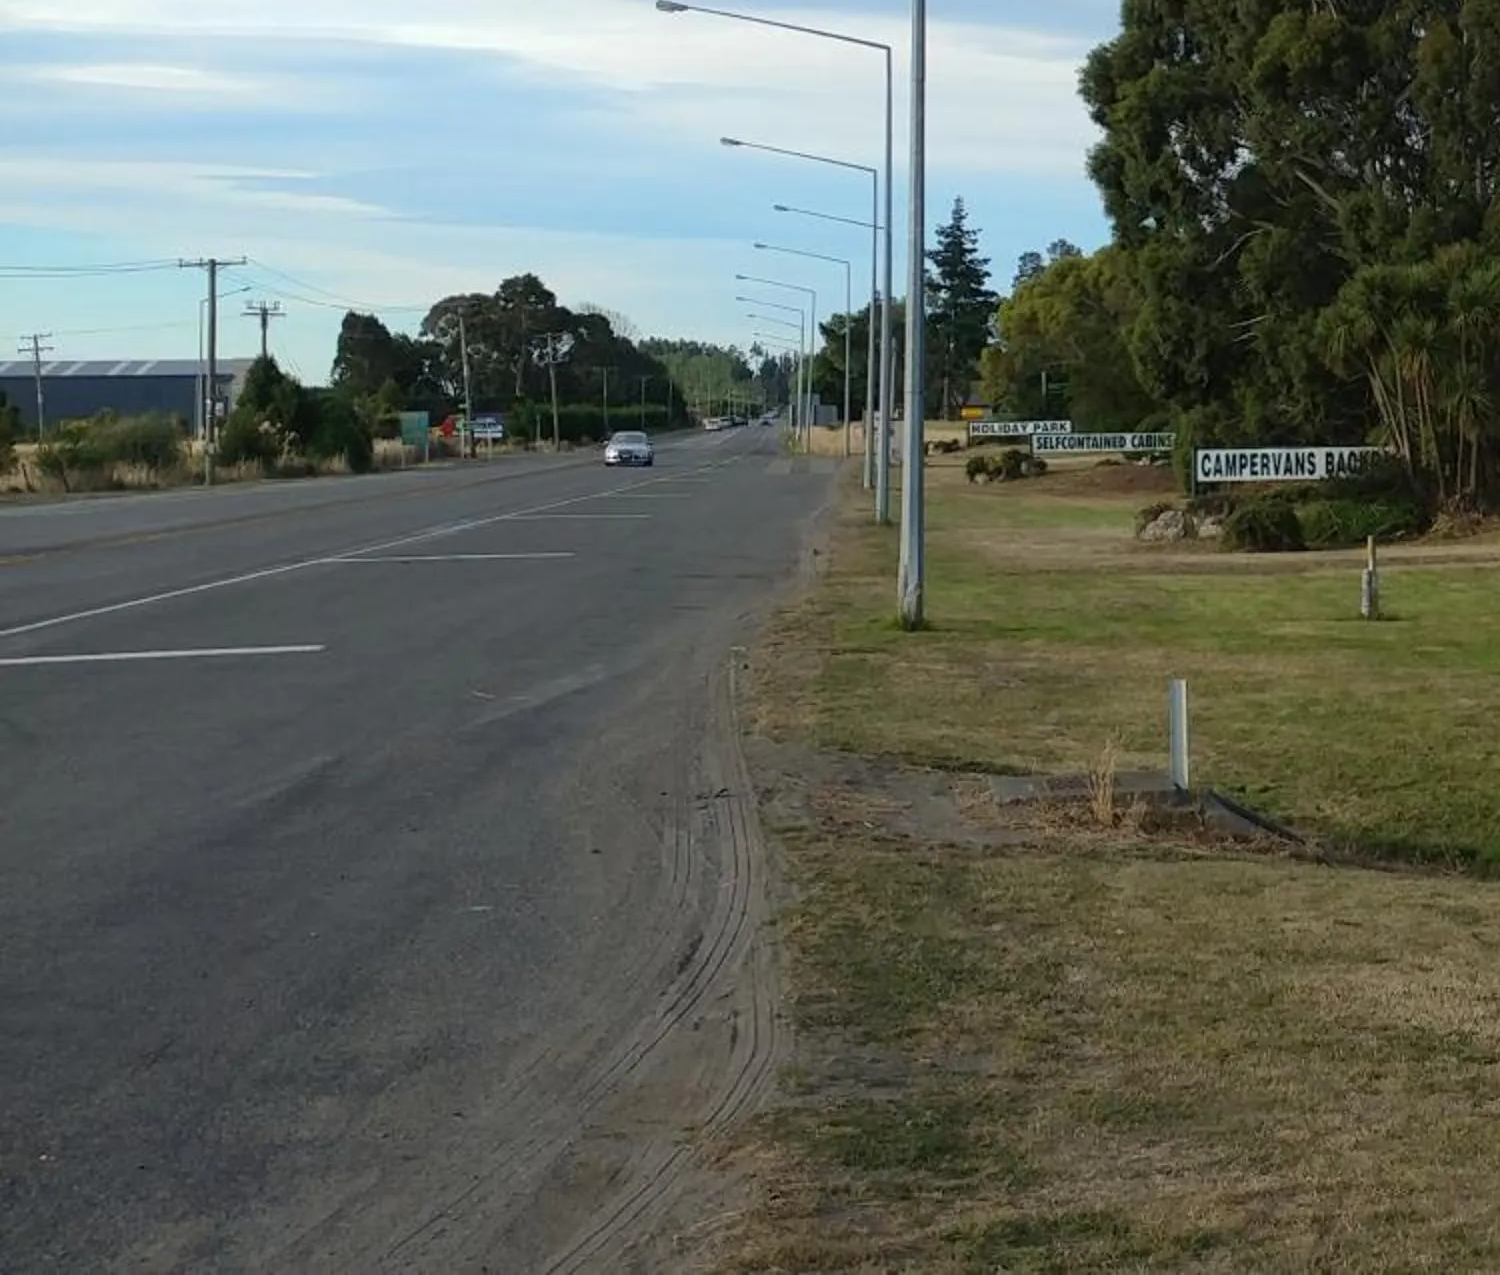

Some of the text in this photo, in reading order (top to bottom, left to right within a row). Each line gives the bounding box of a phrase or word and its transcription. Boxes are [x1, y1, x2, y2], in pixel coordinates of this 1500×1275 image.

[971, 421, 1067, 434] HOLIDAY PARK
[1035, 434, 1174, 450] SELFCONTAINED CABINS
[1201, 451, 1317, 478] CAMPERVANS
